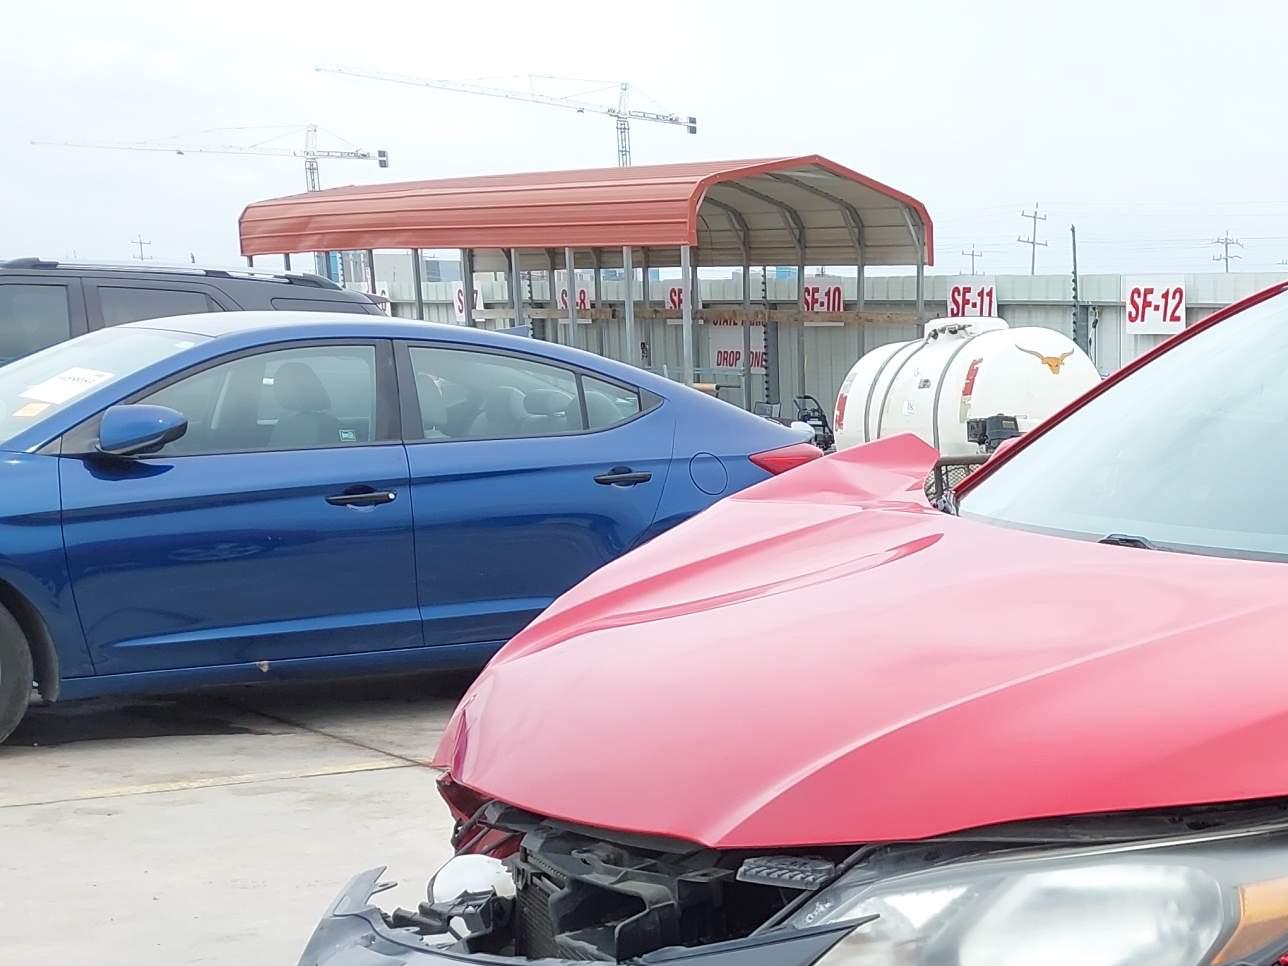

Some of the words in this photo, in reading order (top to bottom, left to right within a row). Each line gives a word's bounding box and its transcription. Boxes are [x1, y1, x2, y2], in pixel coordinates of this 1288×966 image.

[950, 286, 994, 317] SF-11
[1127, 286, 1185, 323] SF-12
[716, 350, 742, 367] DROP
[748, 351, 767, 369] ONE
